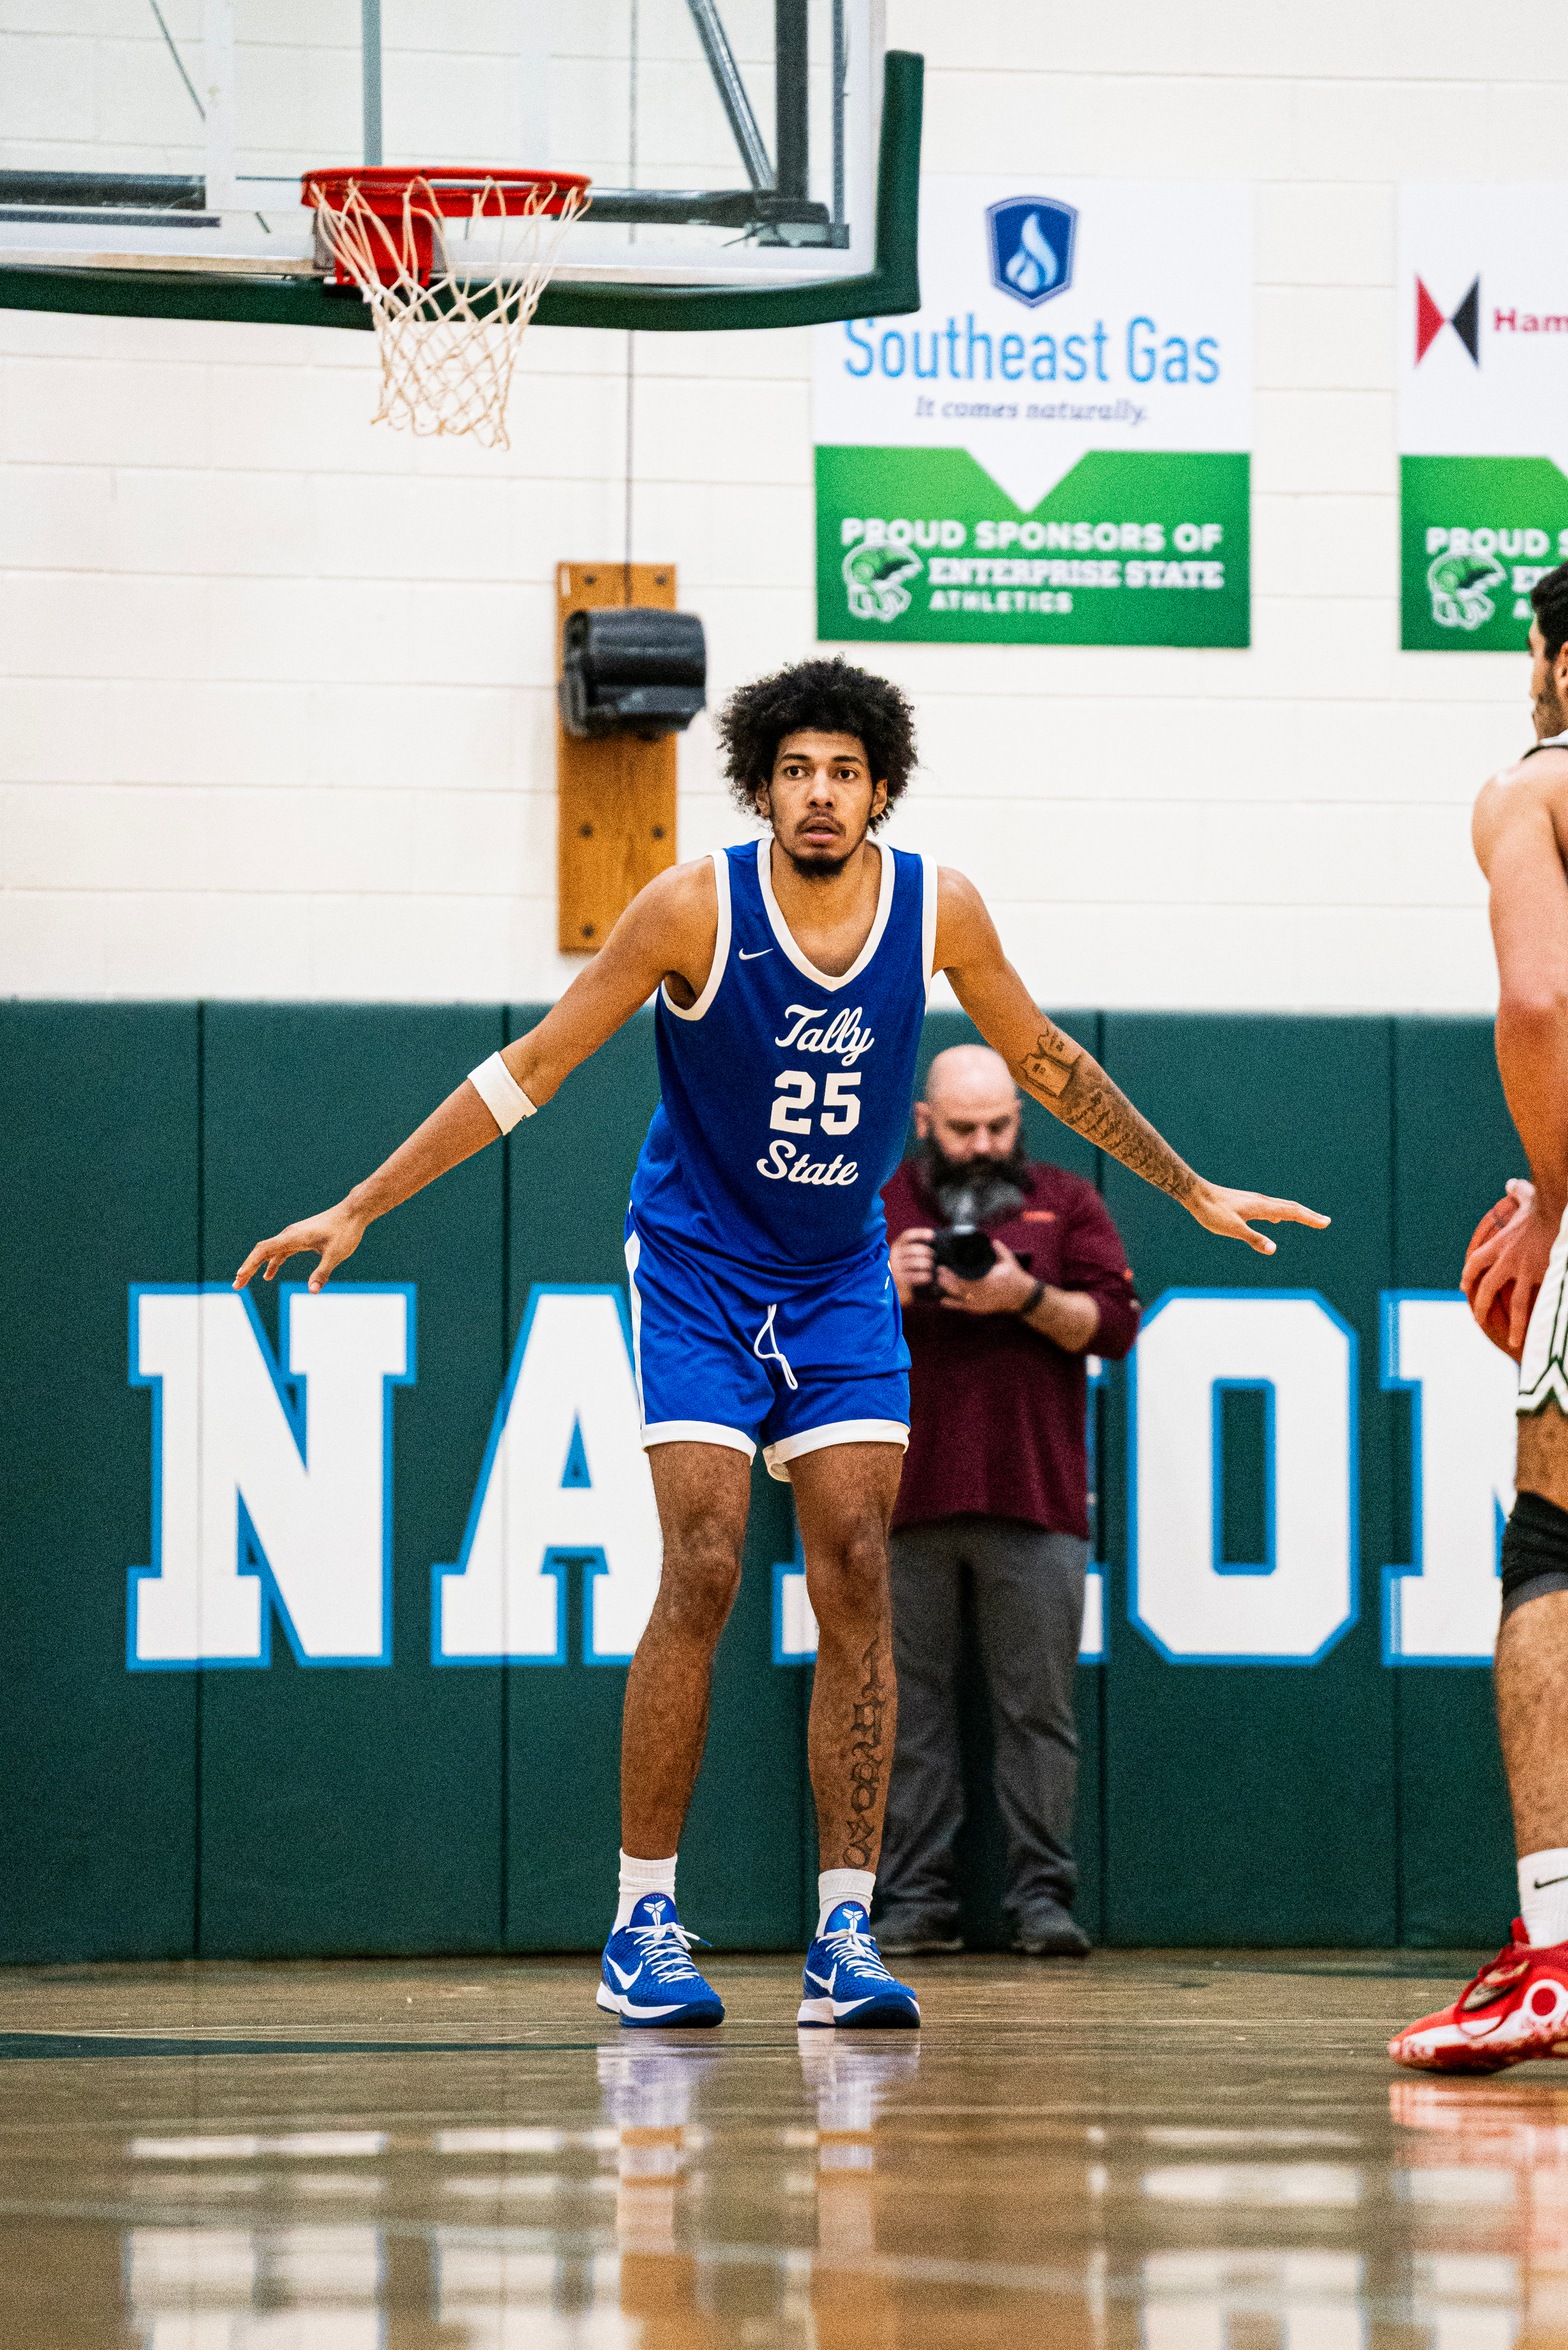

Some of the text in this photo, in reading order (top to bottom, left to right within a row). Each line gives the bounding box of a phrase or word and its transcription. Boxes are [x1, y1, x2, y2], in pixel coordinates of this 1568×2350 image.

[844, 312, 1220, 384] Southeast Gas
[915, 396, 935, 417] It
[941, 400, 1018, 419] comes
[841, 518, 1223, 552] PROUD SPONSORS OF
[1426, 527, 1550, 557] PROUD
[928, 557, 1225, 589] ENTERPRISE STATE
[929, 590, 1074, 614] ATHLETICS
[775, 1004, 875, 1067] Tally
[770, 1069, 862, 1136] 25
[756, 1139, 859, 1186] State
